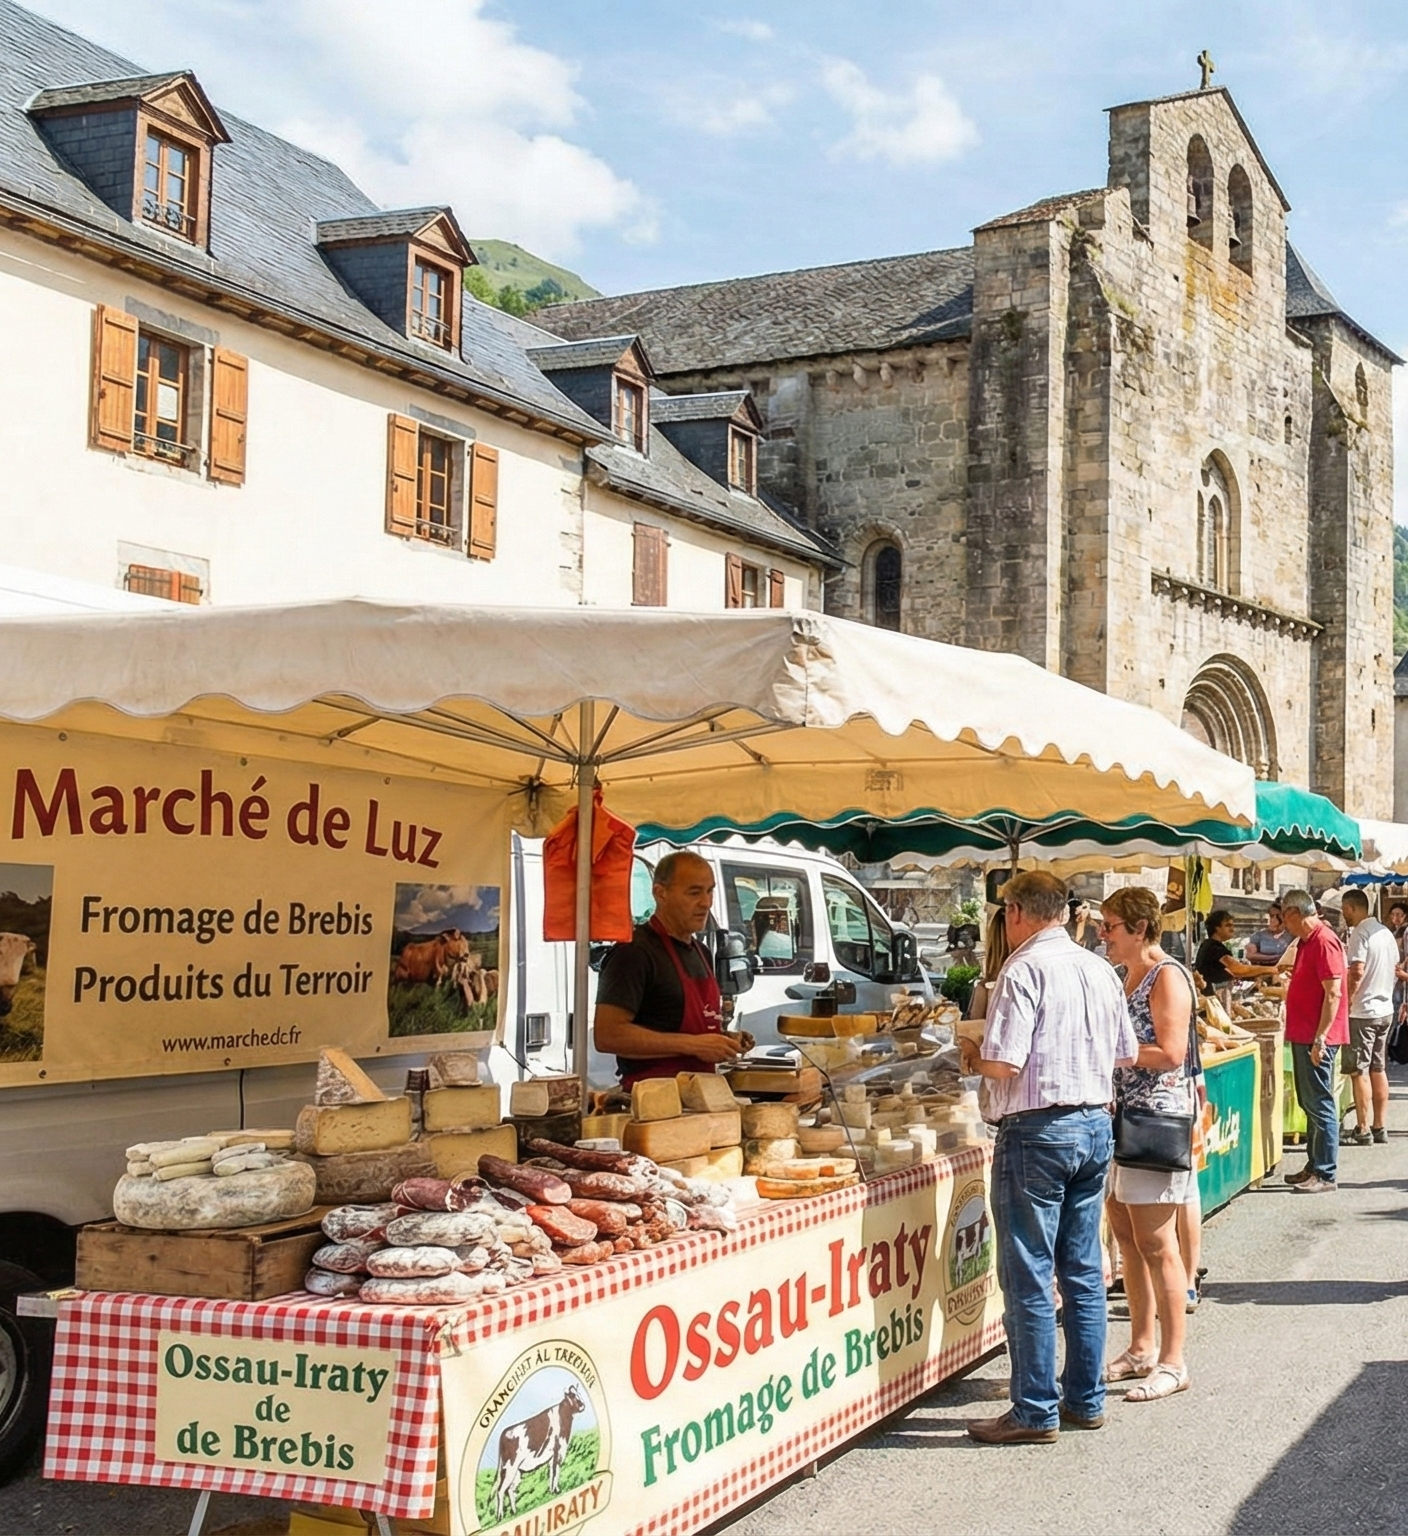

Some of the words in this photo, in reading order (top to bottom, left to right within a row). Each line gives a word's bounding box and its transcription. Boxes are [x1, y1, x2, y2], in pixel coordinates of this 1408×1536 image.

[11, 768, 270, 840] Marché
[286, 782, 351, 850] de
[365, 799, 443, 869] Luz
[81, 895, 235, 944] Fromage
[243, 898, 280, 935] de
[288, 901, 374, 937] Brebis
[73, 963, 224, 1003] Produits
[233, 961, 271, 999] du
[279, 961, 374, 997] Terroir
[630, 1220, 932, 1401] Ossau-Iraty
[164, 1343, 390, 1404] Ossau-Iraty
[641, 1373, 795, 1488] Fromage
[801, 1346, 837, 1400] de
[844, 1302, 925, 1377] Brebis
[255, 1394, 291, 1423] de
[176, 1420, 221, 1458] de
[232, 1424, 356, 1471] Brebis
